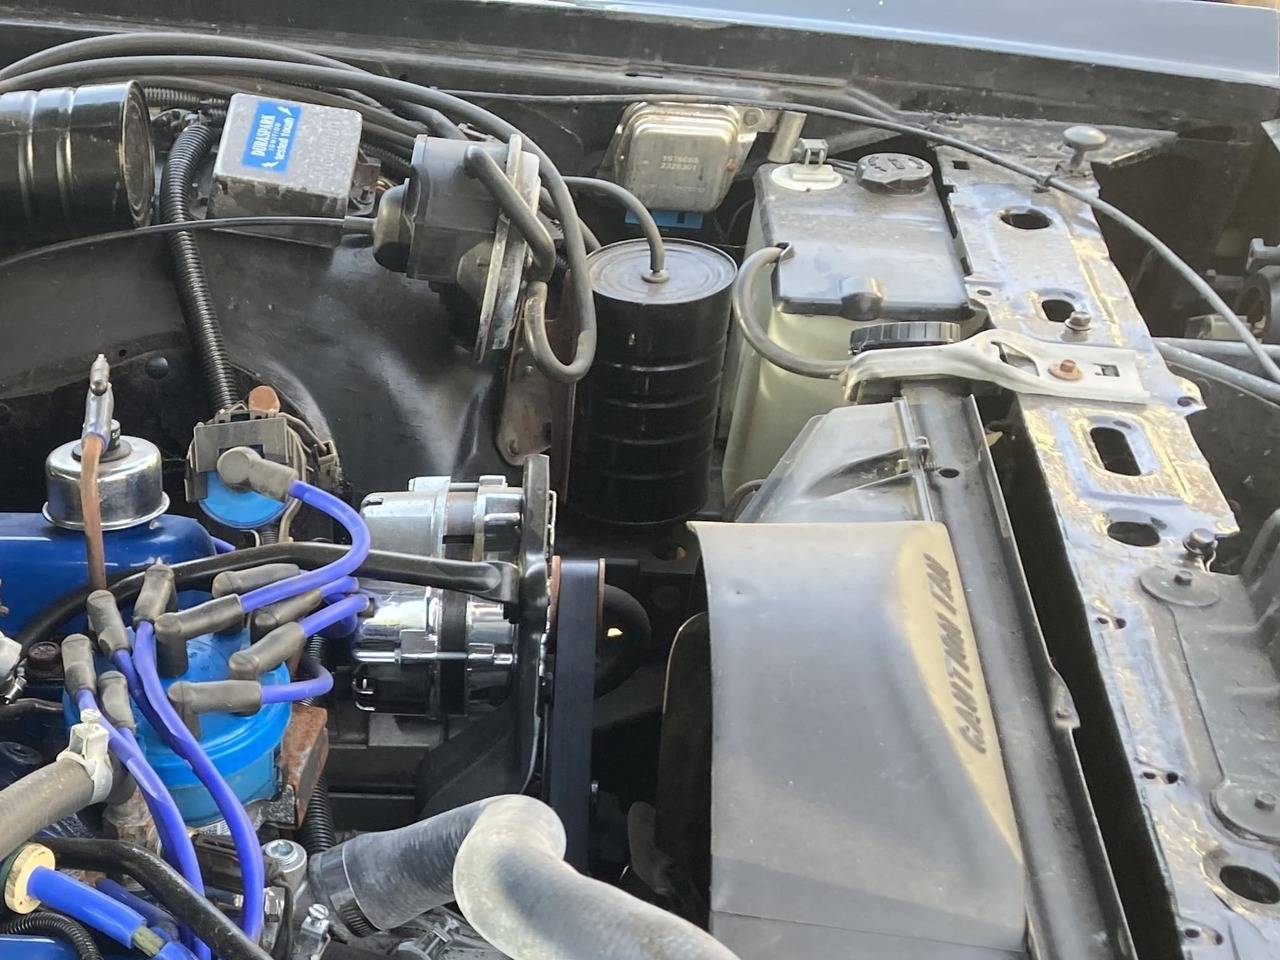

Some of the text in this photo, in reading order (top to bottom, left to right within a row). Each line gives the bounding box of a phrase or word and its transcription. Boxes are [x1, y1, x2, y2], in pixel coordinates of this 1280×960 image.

[251, 114, 276, 157] DURASPARK
[274, 138, 288, 160] tested
[923, 552, 957, 615] FAN
